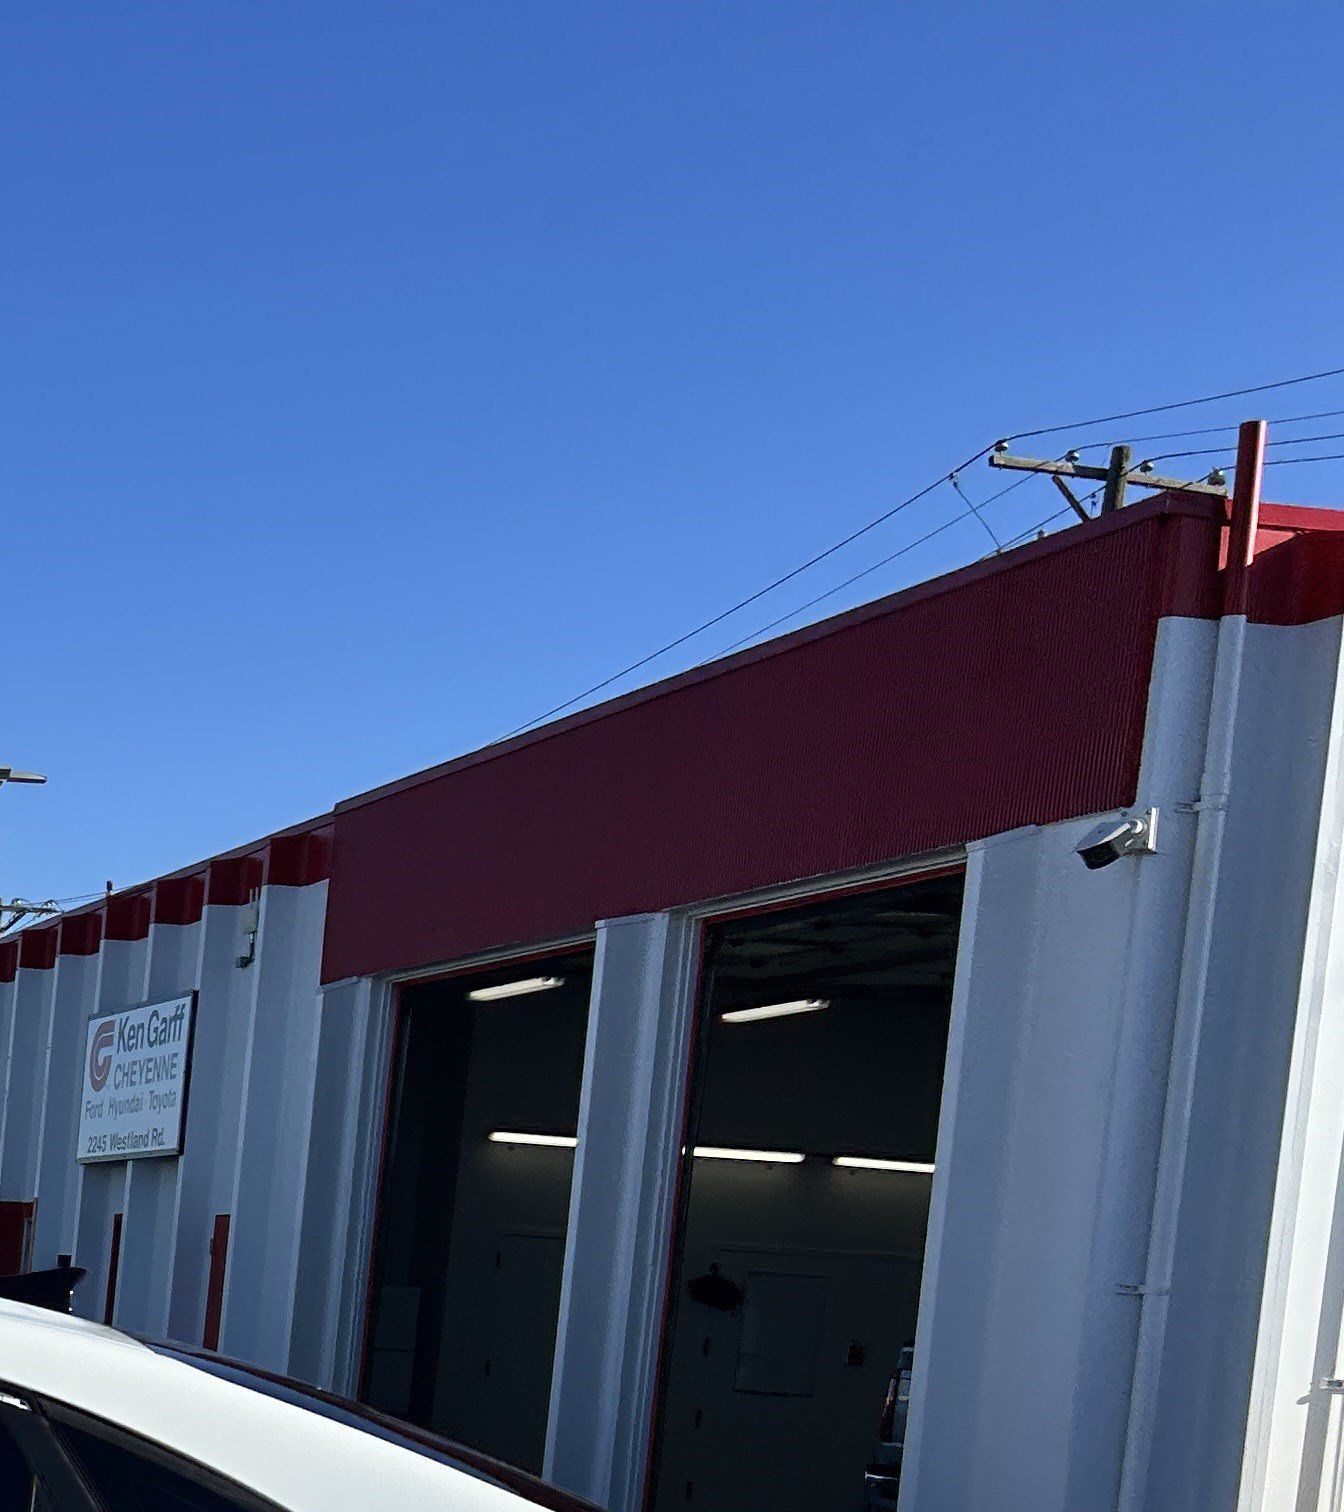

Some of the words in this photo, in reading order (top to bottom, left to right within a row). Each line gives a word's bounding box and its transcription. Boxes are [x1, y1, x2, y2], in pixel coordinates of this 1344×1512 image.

[116, 1016, 145, 1054] Ken
[147, 1003, 186, 1048] Garff
[113, 1052, 179, 1090] CHEYENNE
[85, 1097, 104, 1120] Ford
[107, 1091, 144, 1121] Hyundai
[148, 1088, 177, 1115] Toyota
[87, 1134, 108, 1154] 2245
[109, 1127, 151, 1151] Westland
